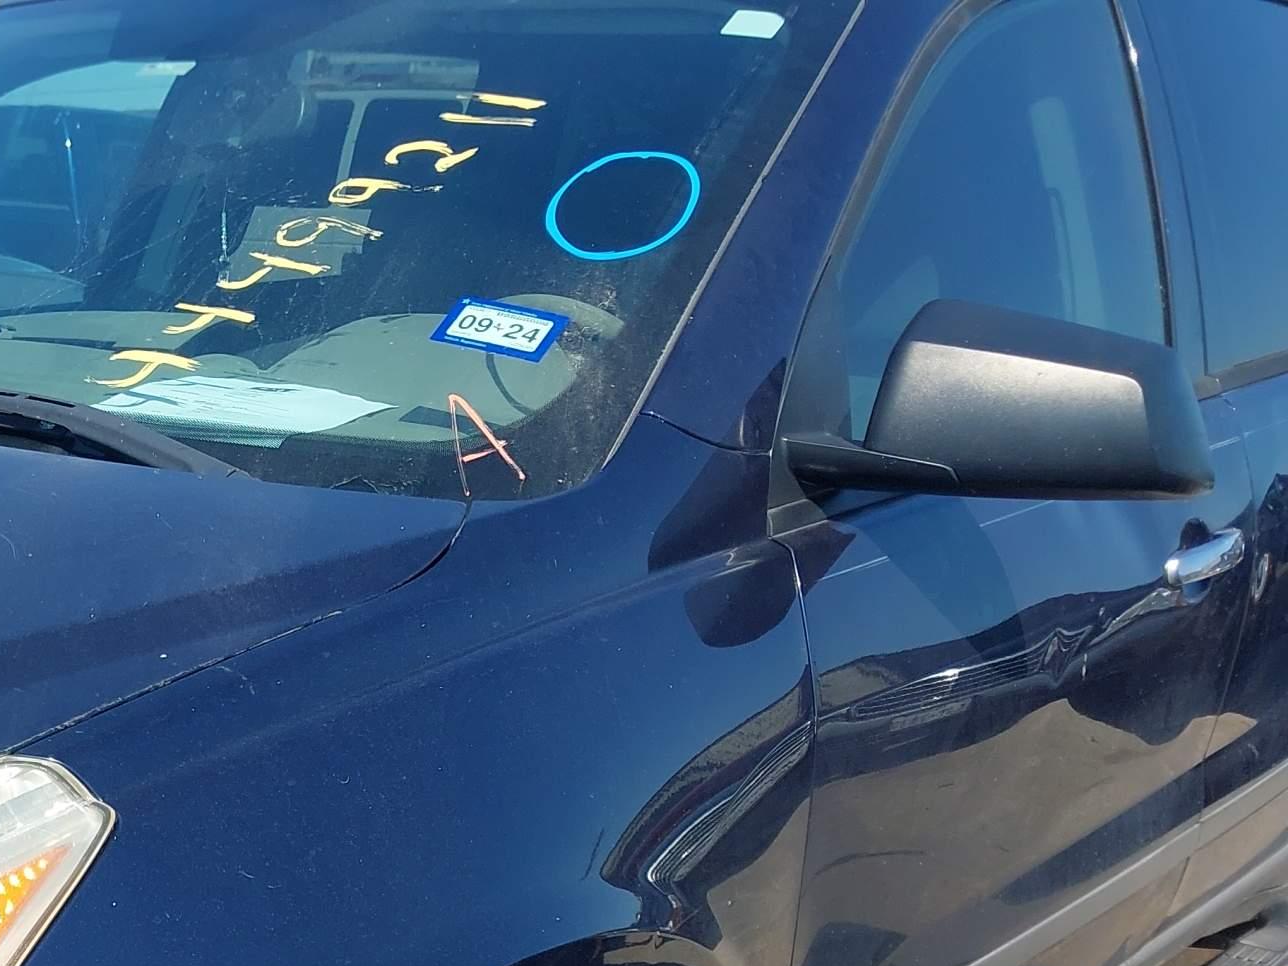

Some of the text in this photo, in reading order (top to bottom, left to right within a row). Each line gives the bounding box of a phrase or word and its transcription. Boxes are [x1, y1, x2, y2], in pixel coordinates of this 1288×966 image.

[457, 314, 494, 333] 09
[502, 323, 541, 343] 24
[448, 394, 526, 496] A
